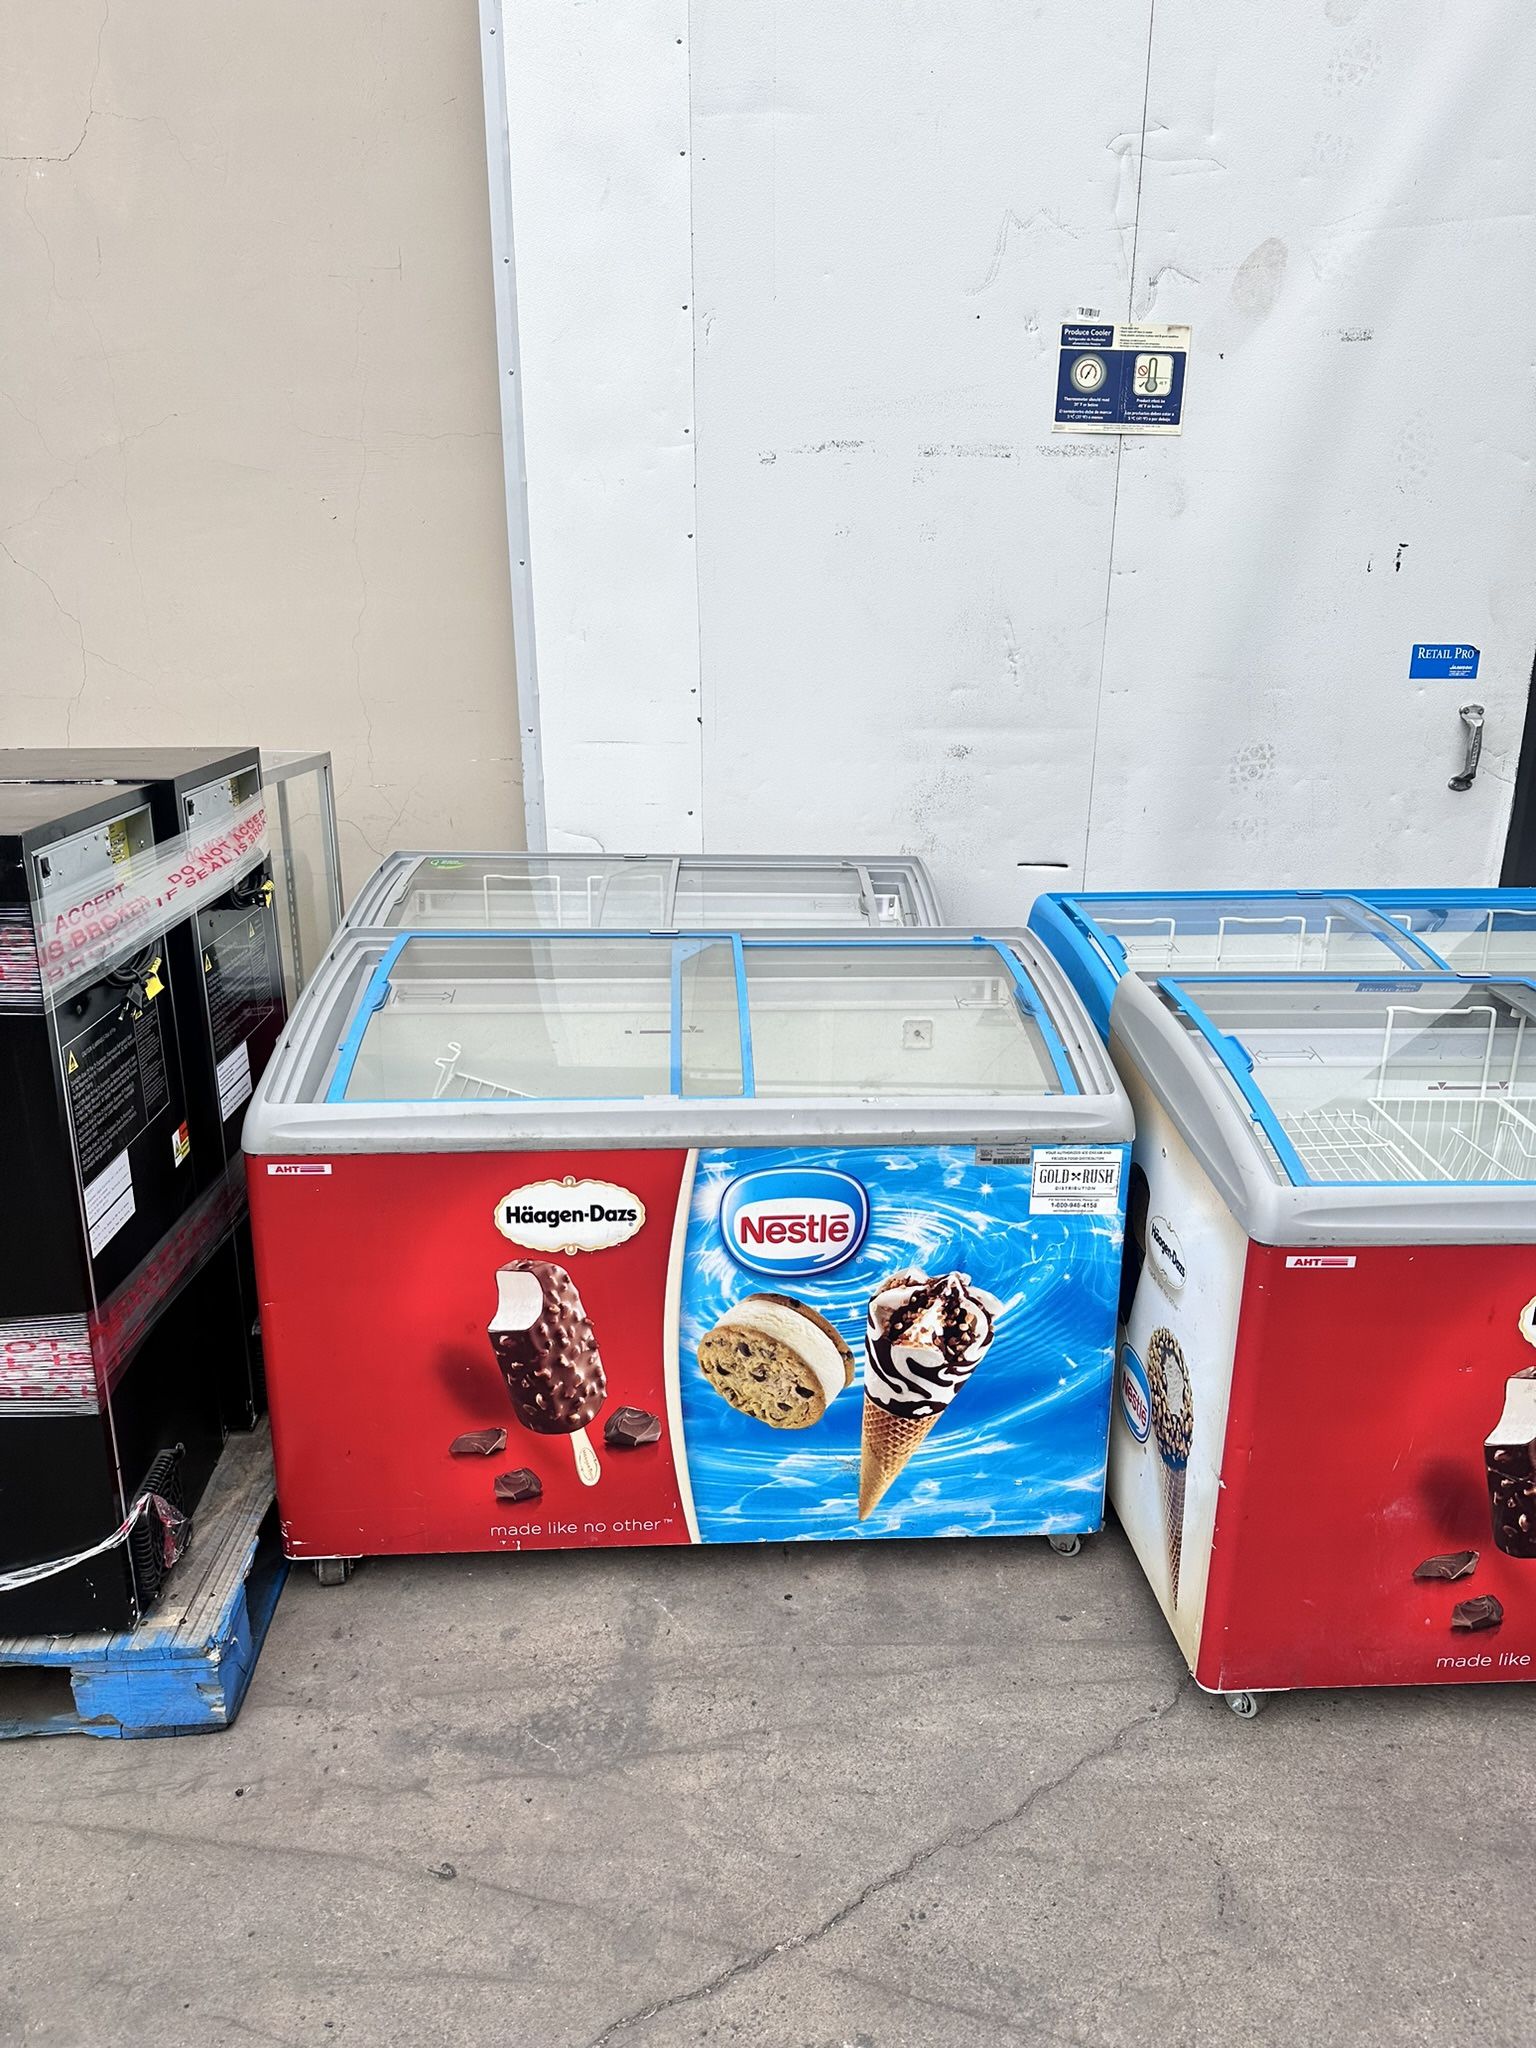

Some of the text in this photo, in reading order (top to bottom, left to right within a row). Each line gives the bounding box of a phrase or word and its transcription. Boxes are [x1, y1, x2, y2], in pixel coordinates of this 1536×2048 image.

[1064, 328, 1090, 336] Produce
[168, 866, 195, 884] DO
[198, 840, 231, 864] NOT
[233, 809, 265, 841] ACCEP
[184, 855, 232, 888] SEAL
[1040, 1169, 1114, 1184] GOLD RUSH
[506, 1205, 637, 1228] Häagen-Dazs
[741, 1214, 850, 1244] Nestlé
[490, 1523, 541, 1536] made
[549, 1522, 578, 1534] like
[584, 1522, 606, 1533] no
[1436, 1652, 1531, 1668] made like
